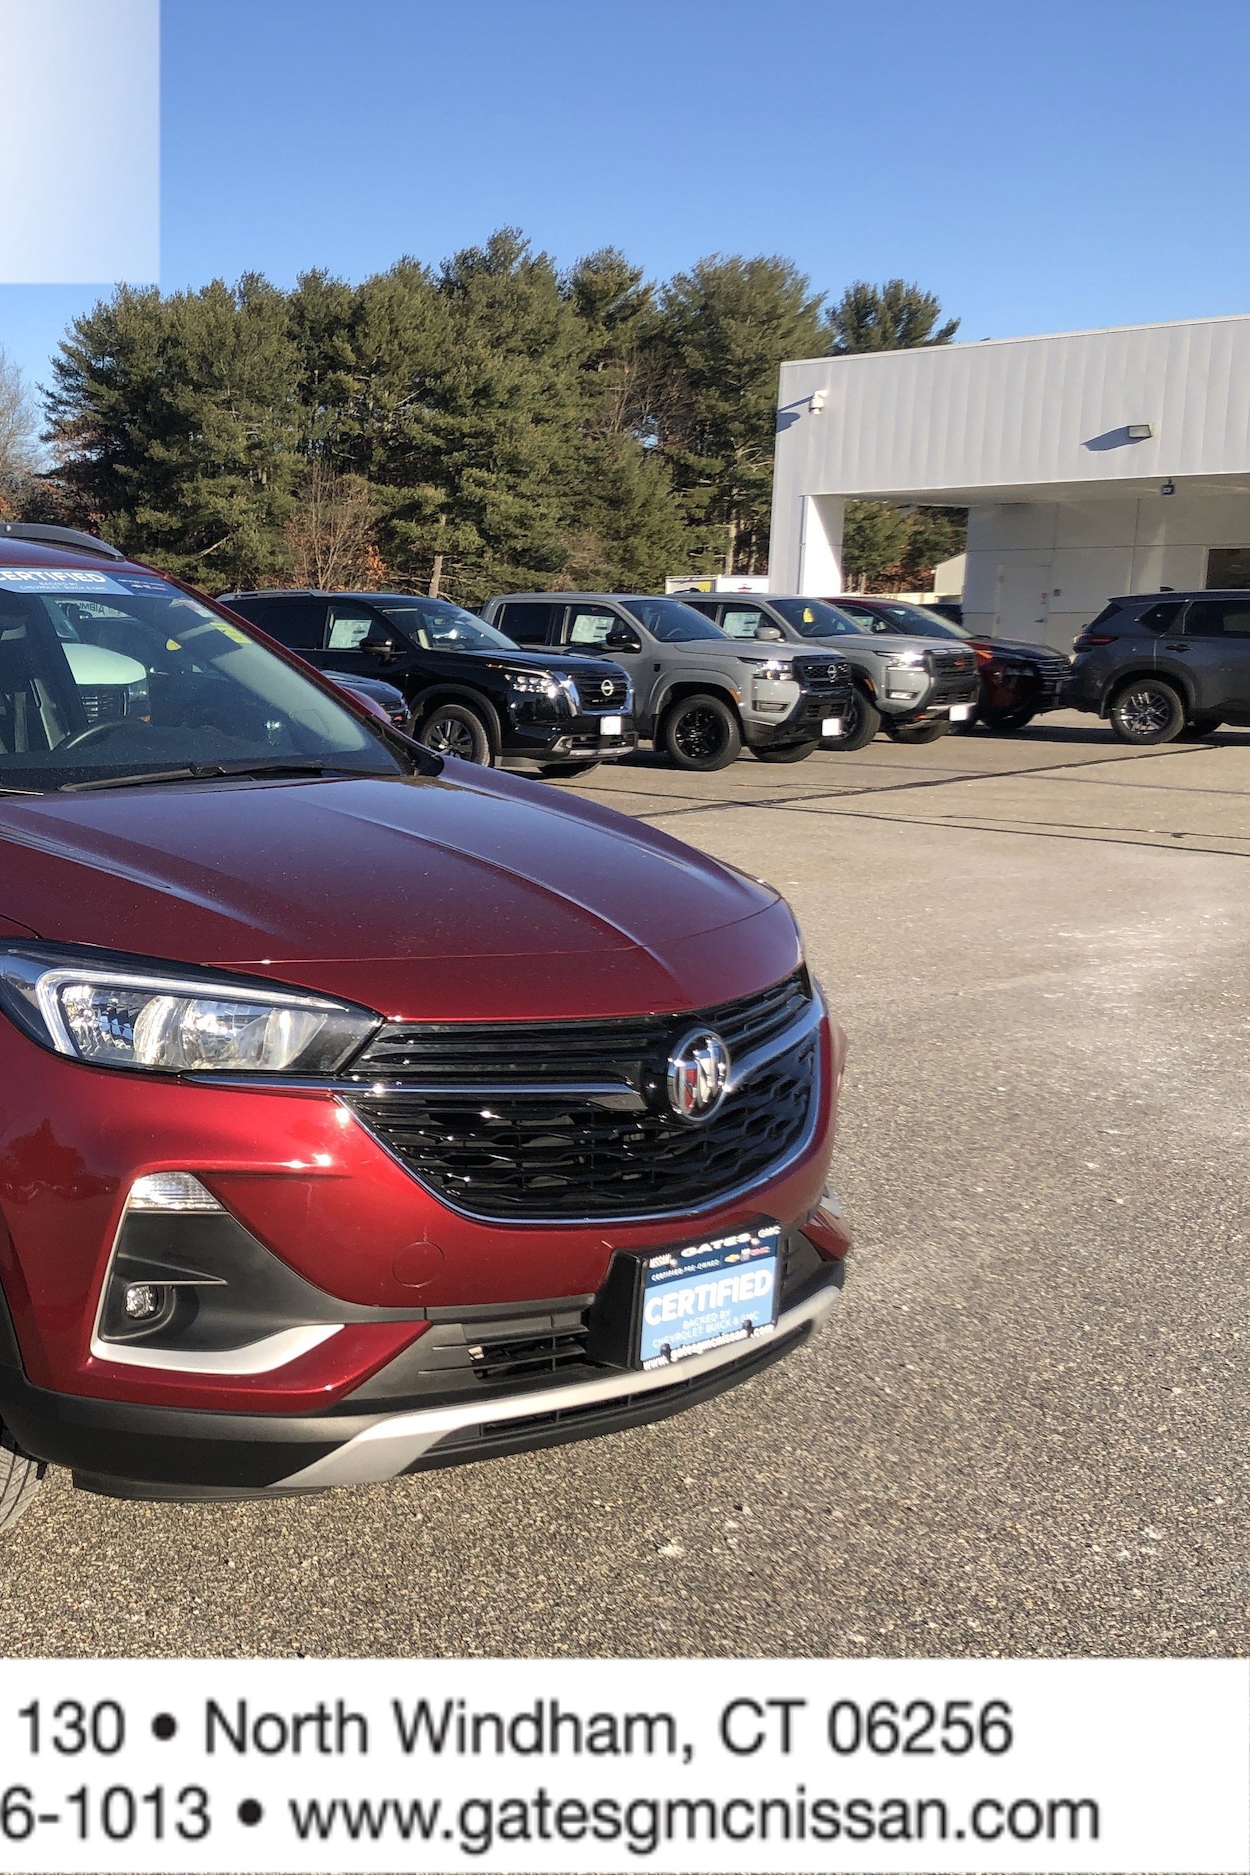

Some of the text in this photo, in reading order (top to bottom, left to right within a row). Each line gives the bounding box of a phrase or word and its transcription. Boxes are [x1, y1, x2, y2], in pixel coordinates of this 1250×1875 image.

[681, 1233, 751, 1257] GATES
[645, 1269, 773, 1325] CERTIFIED
[683, 1308, 732, 1330] BACKED BY
